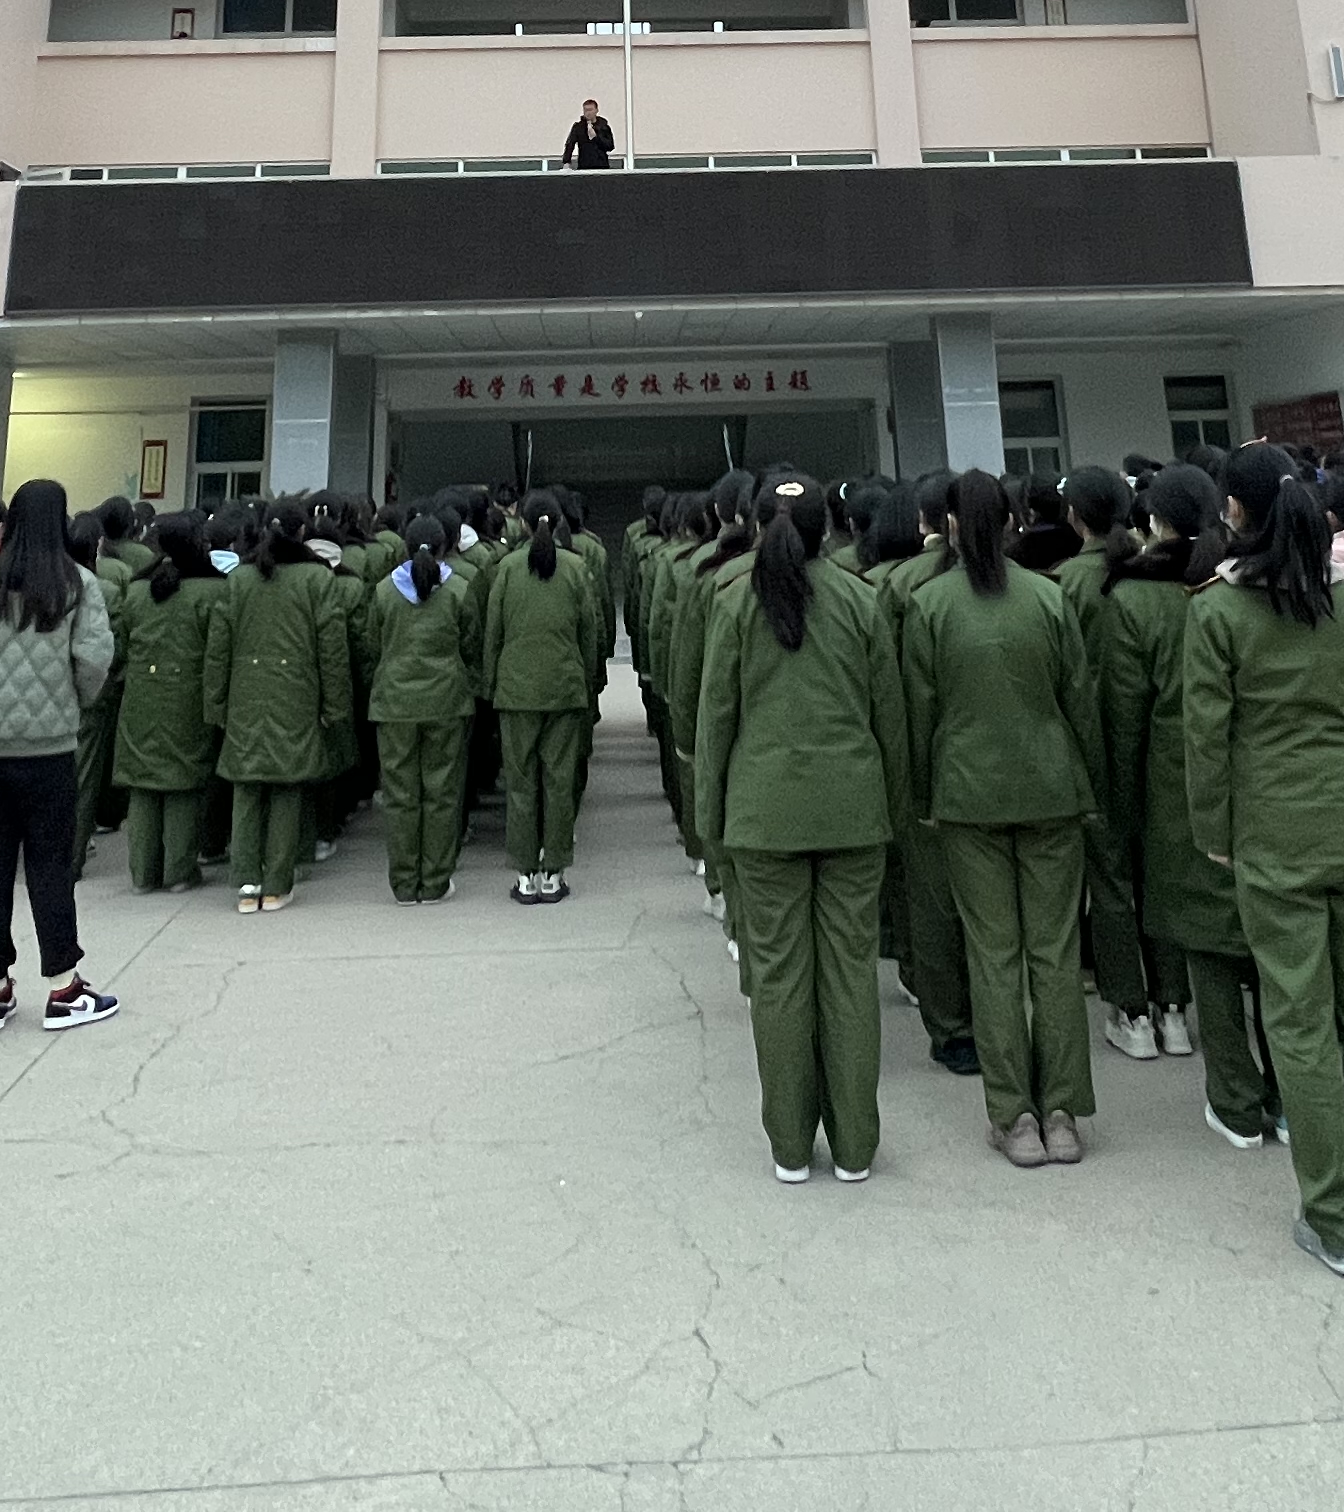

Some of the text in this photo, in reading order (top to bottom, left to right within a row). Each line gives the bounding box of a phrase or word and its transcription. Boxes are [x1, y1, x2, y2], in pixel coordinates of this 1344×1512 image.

[453, 370, 811, 399] 教学质量是学校永恒的主题
